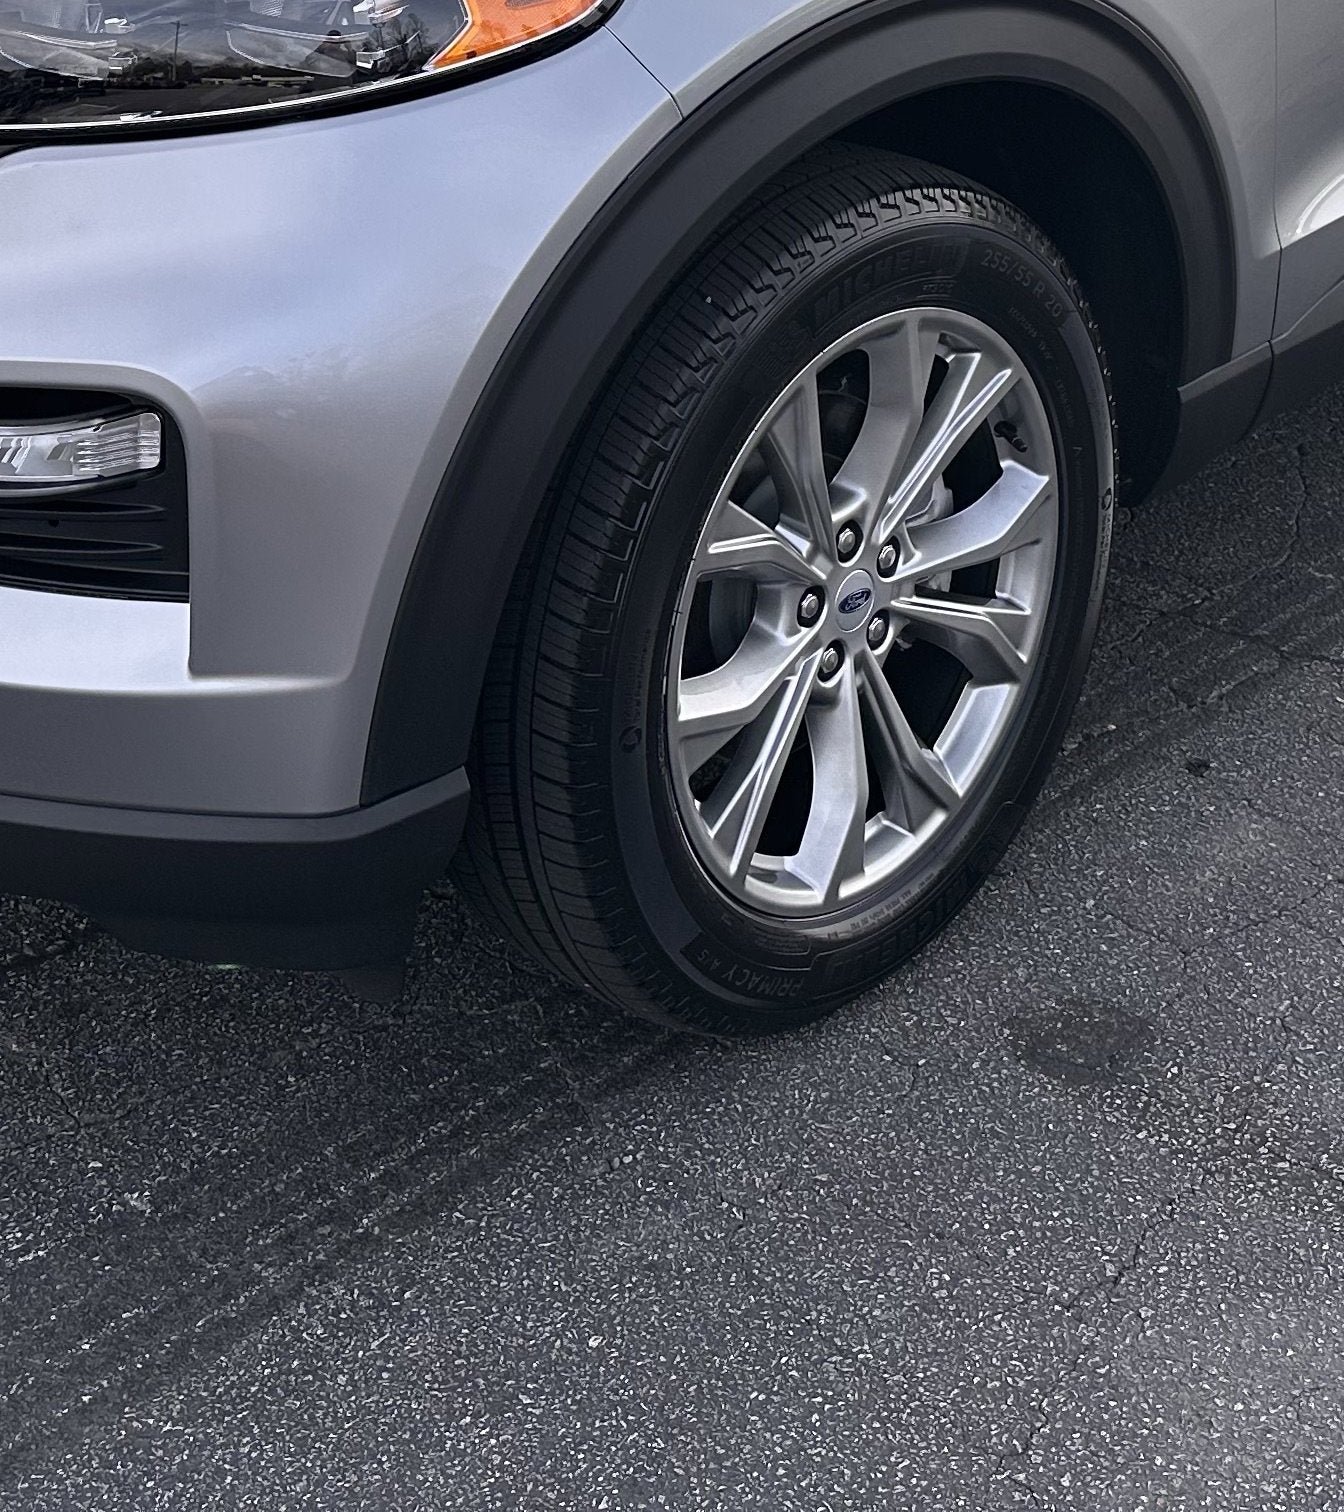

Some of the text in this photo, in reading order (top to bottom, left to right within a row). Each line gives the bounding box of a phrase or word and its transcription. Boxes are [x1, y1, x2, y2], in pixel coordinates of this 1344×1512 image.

[813, 240, 969, 331] MICHELIN
[980, 248, 1033, 290] 255/55
[1033, 283, 1046, 300] R
[1045, 297, 1063, 318] 20
[720, 962, 805, 997] PRIMACY
